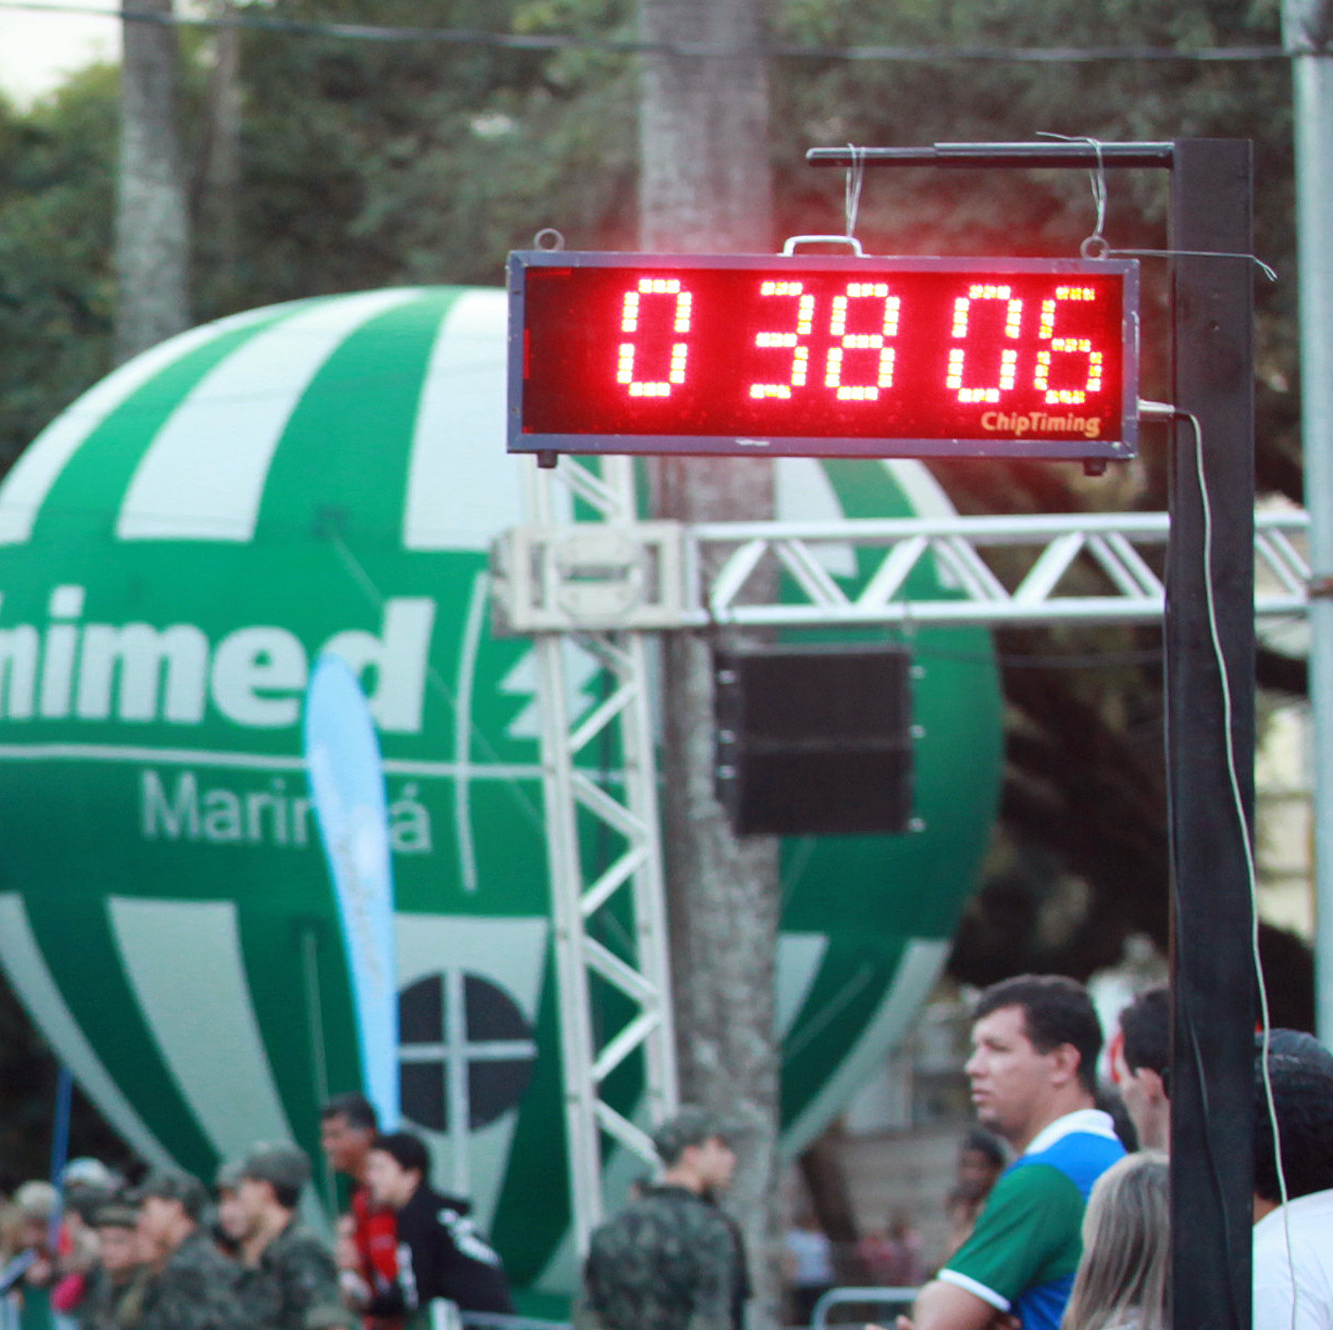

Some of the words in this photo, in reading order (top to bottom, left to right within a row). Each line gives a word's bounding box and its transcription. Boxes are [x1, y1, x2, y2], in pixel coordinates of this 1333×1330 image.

[617, 278, 692, 397] 0
[750, 281, 900, 400] 38
[945, 284, 1103, 404] 06
[981, 412, 1101, 438] ChipTiming
